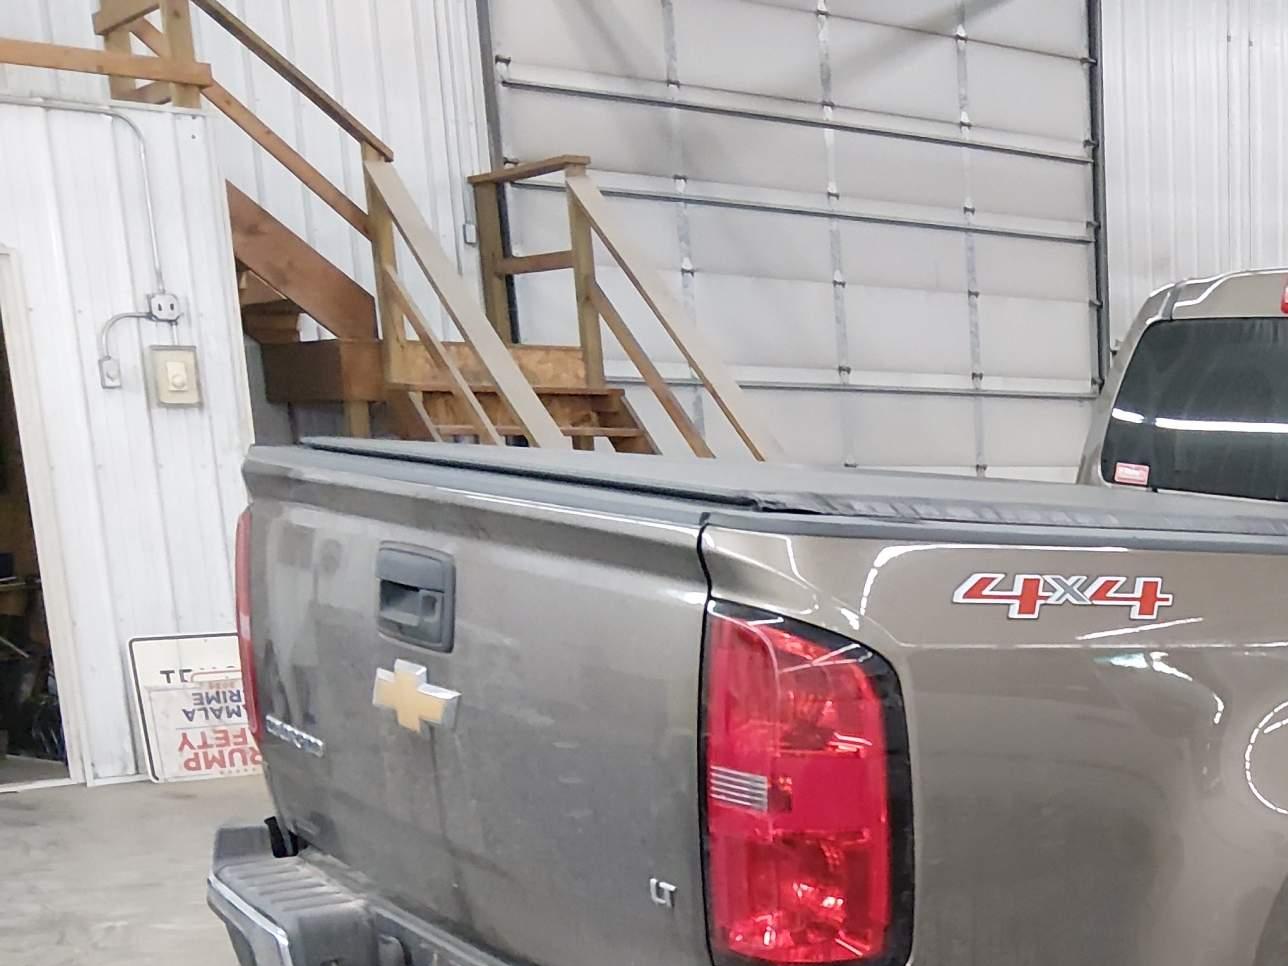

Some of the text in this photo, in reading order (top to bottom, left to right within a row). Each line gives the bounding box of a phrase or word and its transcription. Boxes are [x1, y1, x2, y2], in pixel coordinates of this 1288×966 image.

[192, 689, 241, 706] RIME
[182, 705, 242, 722] MALA
[178, 728, 248, 752] FETY
[184, 746, 263, 772] RUMP
[650, 878, 676, 908] LT
